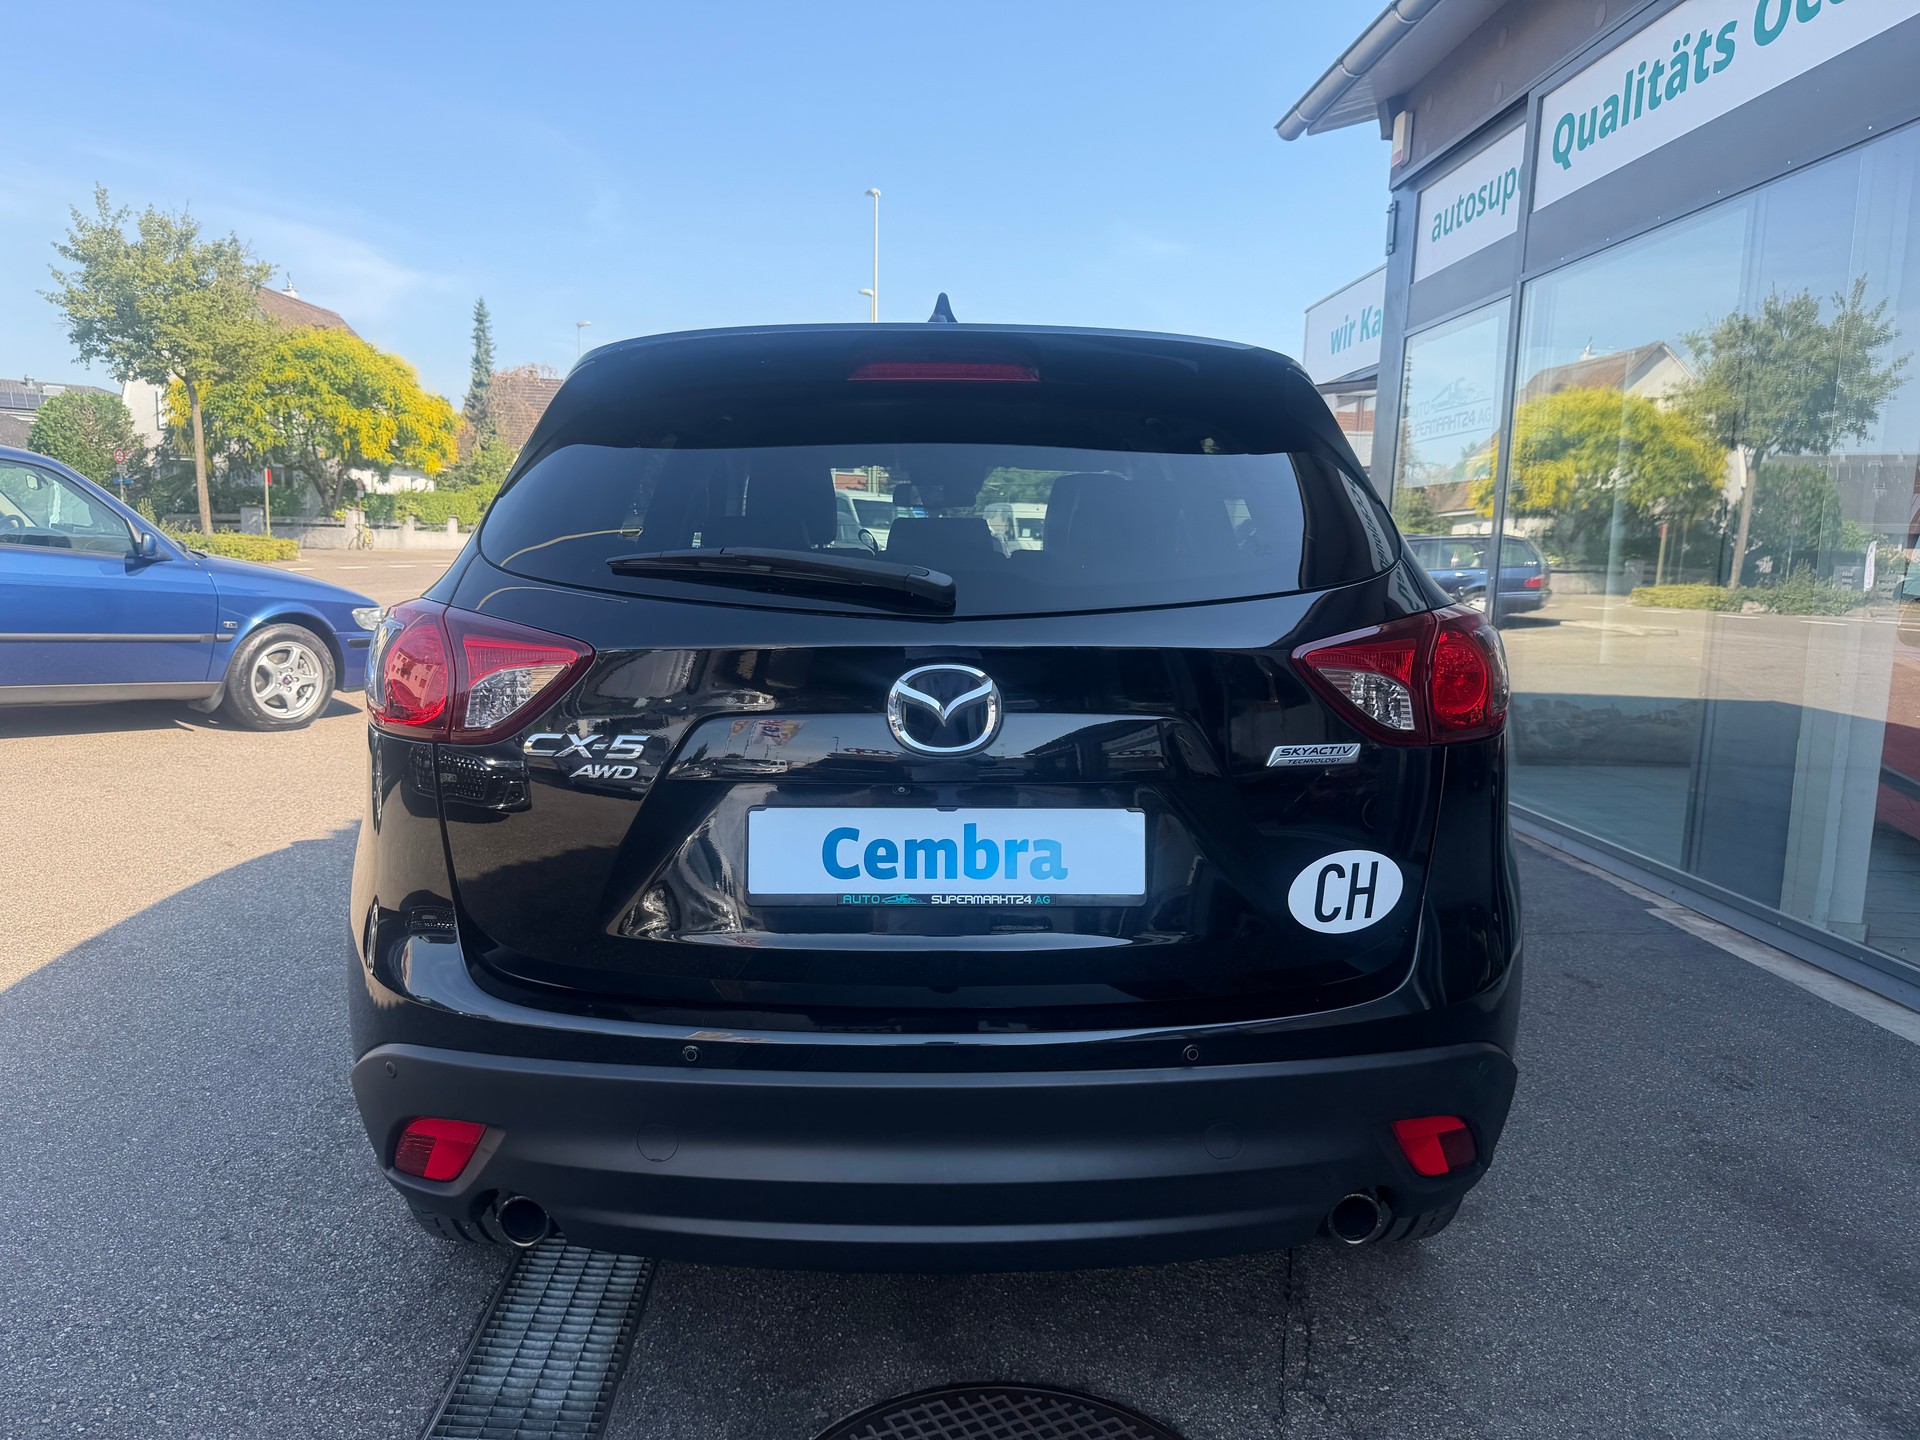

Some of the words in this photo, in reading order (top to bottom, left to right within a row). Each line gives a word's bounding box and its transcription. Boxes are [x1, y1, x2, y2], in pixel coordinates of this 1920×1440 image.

[1552, 20, 1738, 171] Qualitäts
[1330, 314, 1356, 355] wir
[523, 733, 651, 760] CX-5
[1280, 745, 1353, 757] SKYACTIV
[568, 763, 639, 779] AWD
[1287, 757, 1342, 765] TECHNOLOGY
[822, 823, 1068, 881] Cembra
[842, 894, 881, 905] AUTO
[1034, 895, 1051, 905] AG
[1313, 860, 1380, 924] CH
